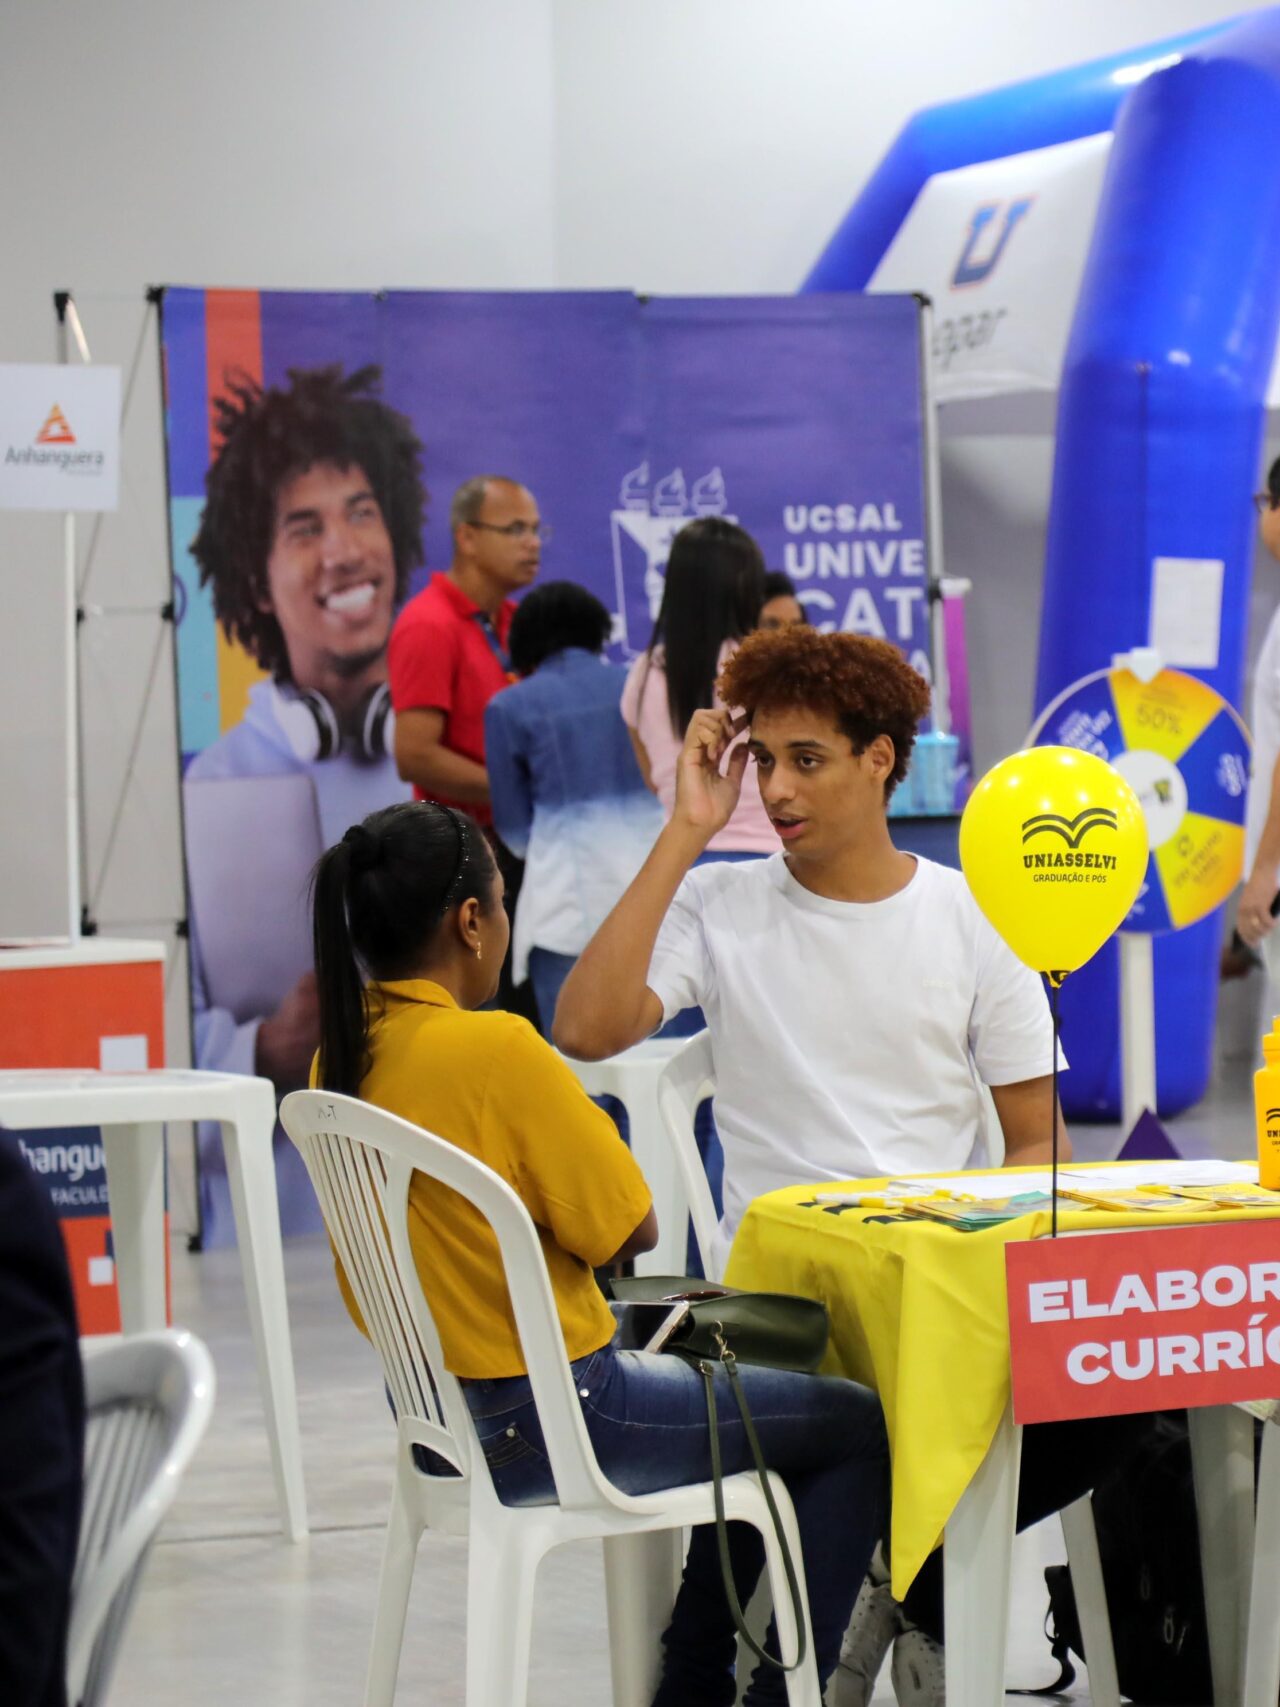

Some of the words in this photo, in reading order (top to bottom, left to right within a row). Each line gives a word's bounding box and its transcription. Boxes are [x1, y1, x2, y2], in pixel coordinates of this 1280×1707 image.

[4, 446, 105, 472] Anhanguera
[784, 504, 902, 533] UCSAL
[1023, 853, 1117, 870] UNIASSELVI
[1033, 872, 1084, 884] GRADUAÇÃO
[1085, 874, 1091, 883] E
[1092, 873, 1107, 884] PÓS
[18, 1139, 106, 1182] hangu
